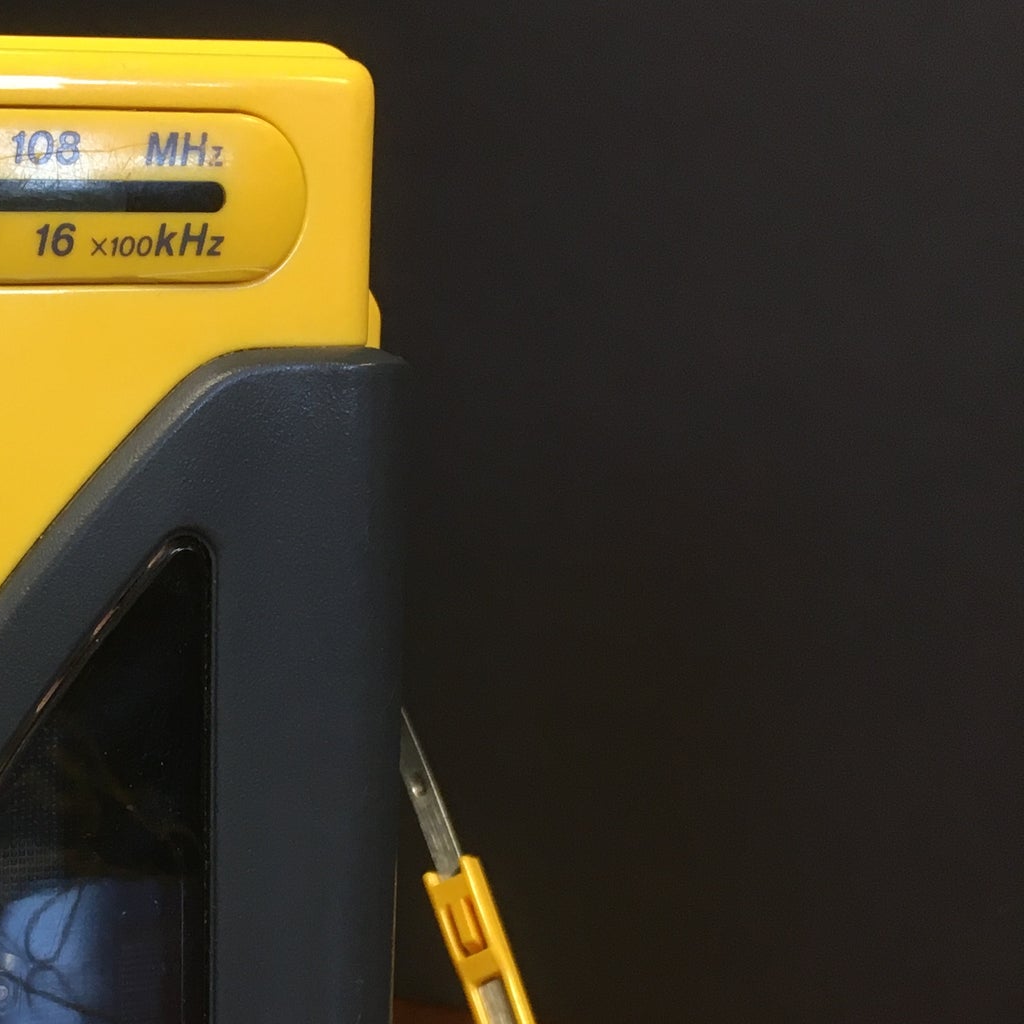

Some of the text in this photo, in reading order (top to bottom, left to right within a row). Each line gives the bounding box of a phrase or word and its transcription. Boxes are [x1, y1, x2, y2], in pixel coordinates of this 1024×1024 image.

[11, 130, 81, 165] 108
[145, 131, 224, 167] MHz
[36, 223, 77, 257] 16
